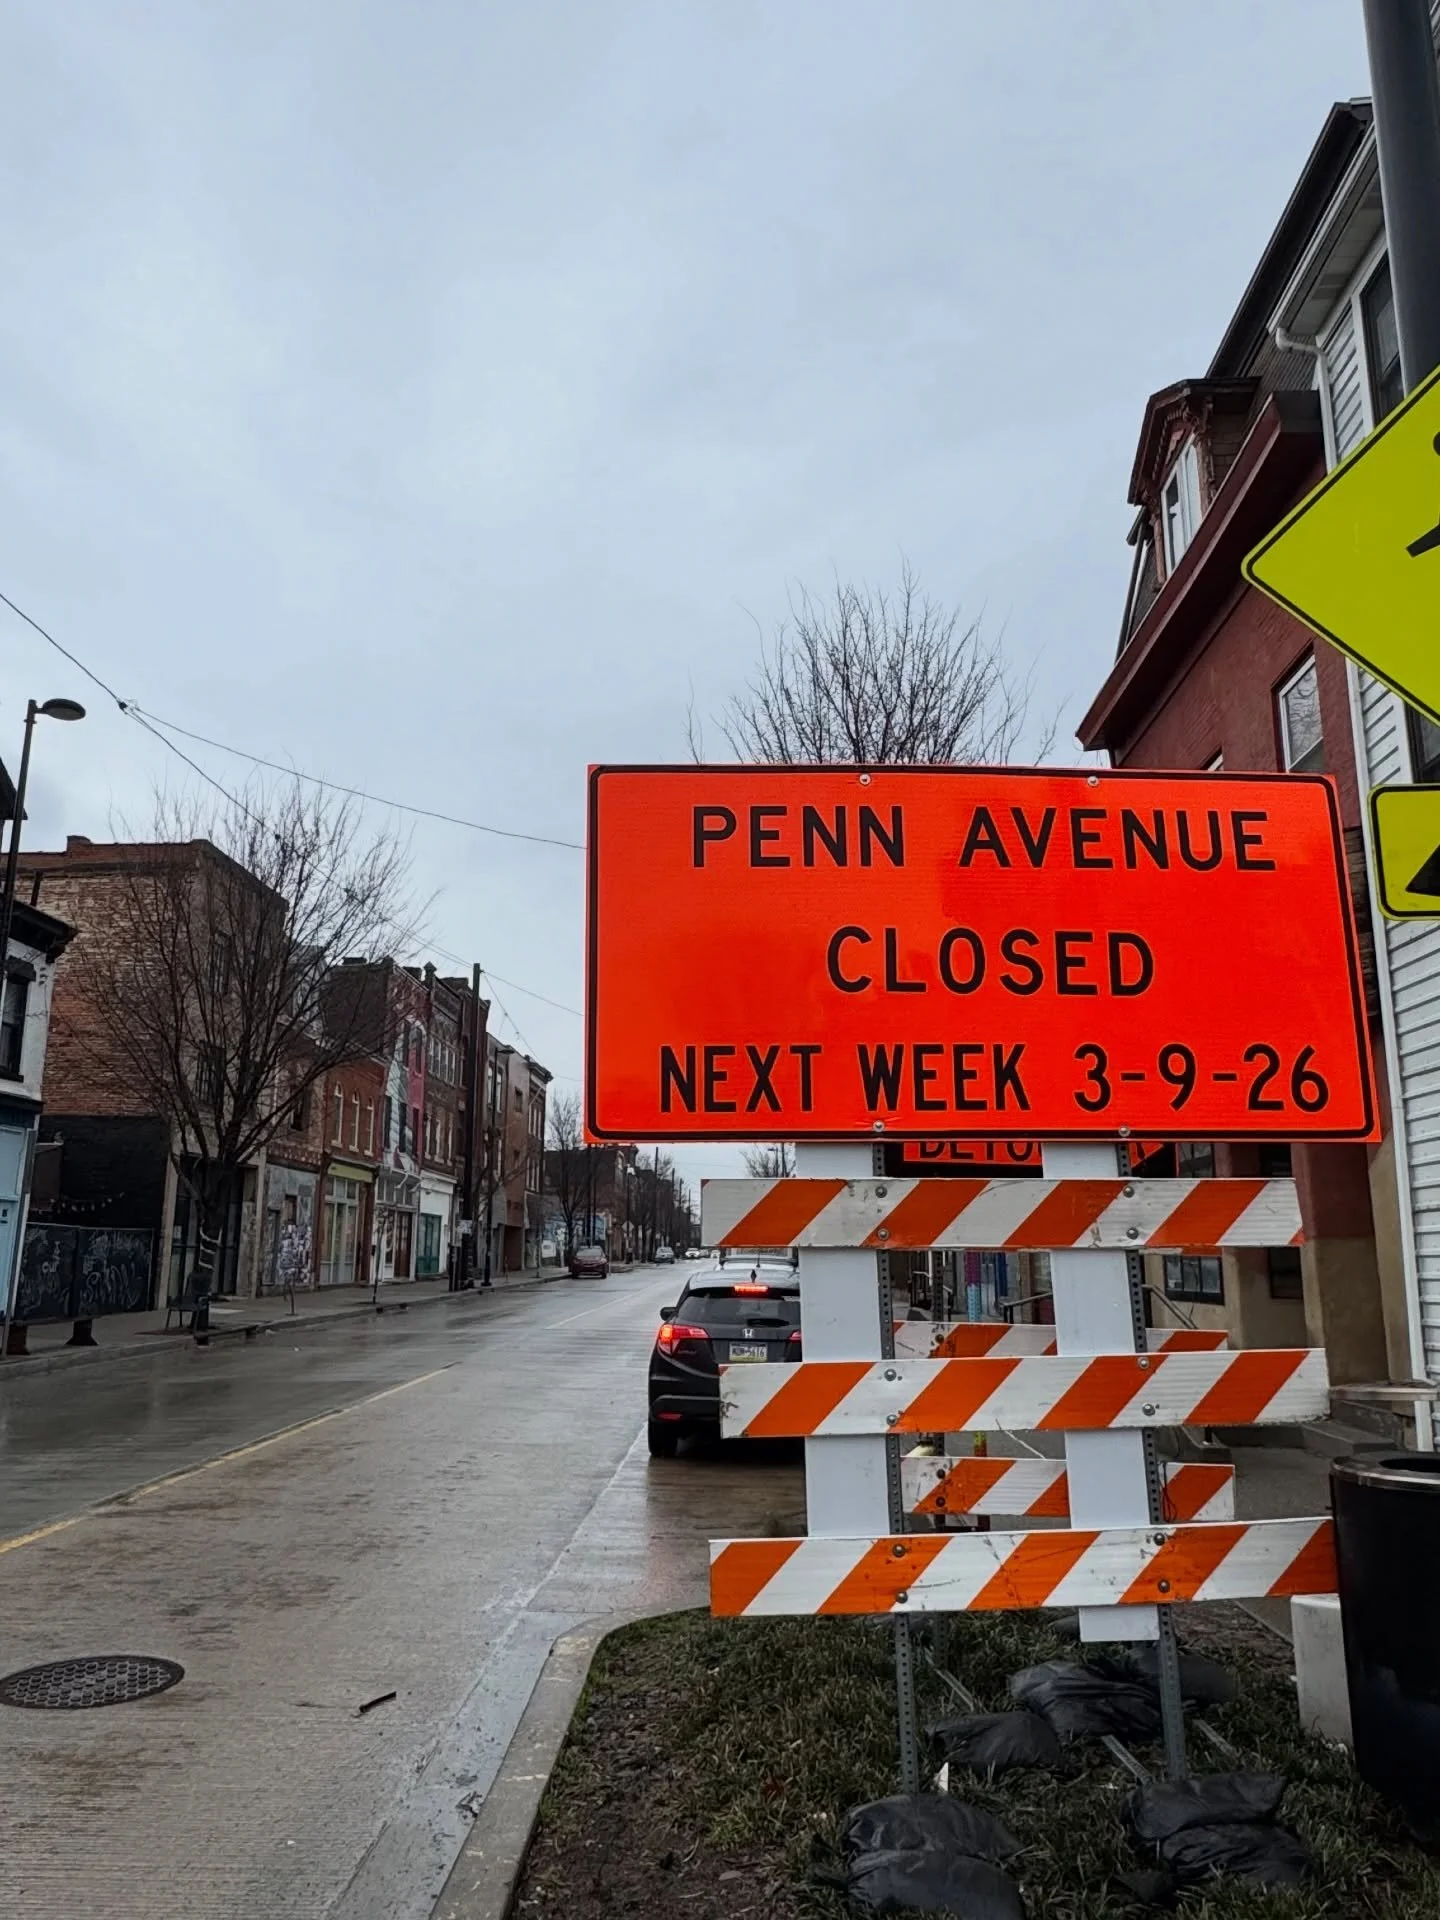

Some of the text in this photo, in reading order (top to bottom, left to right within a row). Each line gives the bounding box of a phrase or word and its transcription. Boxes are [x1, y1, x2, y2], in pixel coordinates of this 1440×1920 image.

[692, 804, 1277, 872] PENN AVENUE
[826, 925, 1155, 997] CLOSED
[660, 1042, 1330, 1114] NEXT WEEK 3-9-26
